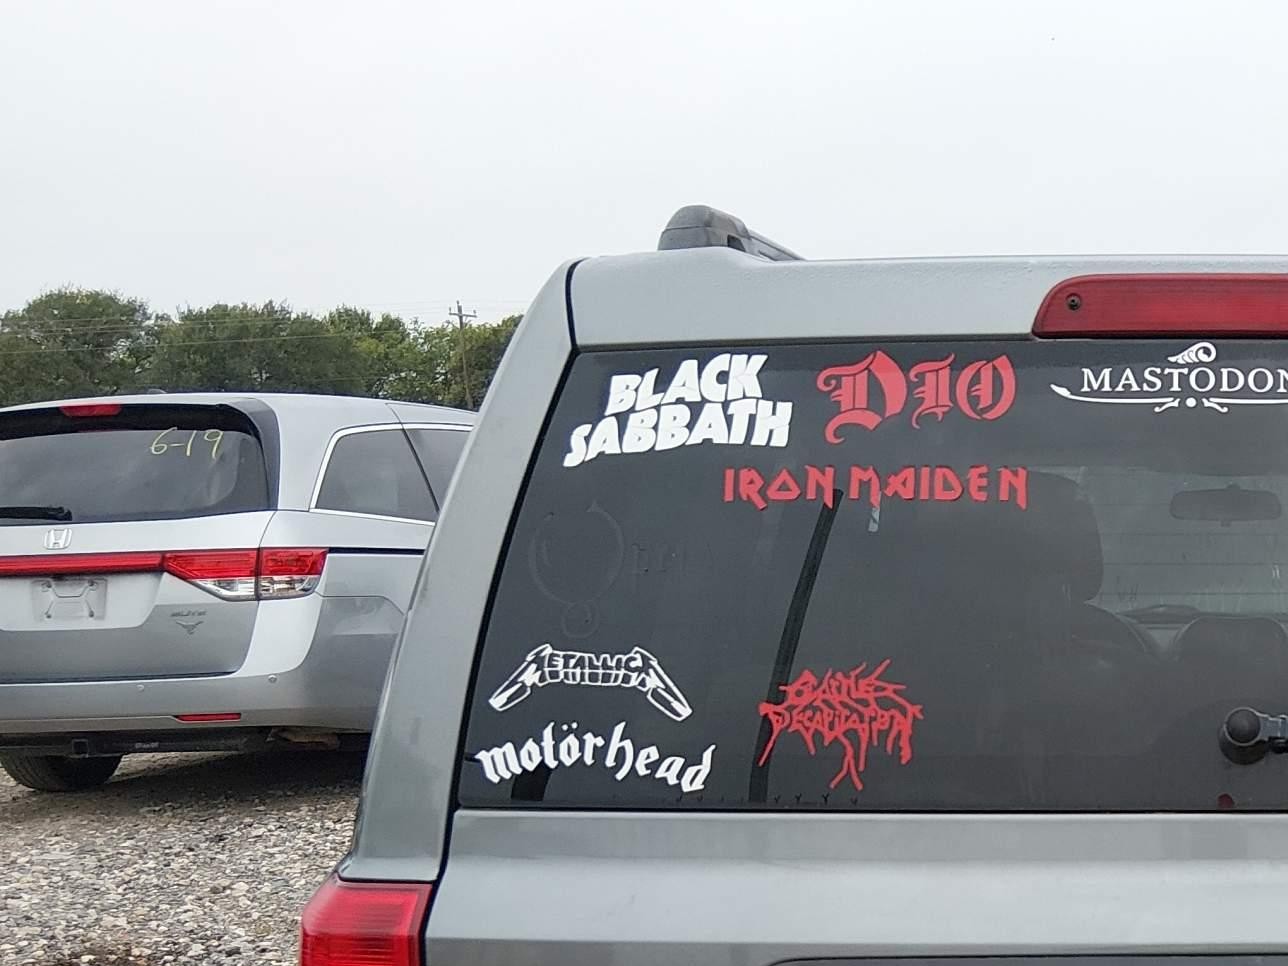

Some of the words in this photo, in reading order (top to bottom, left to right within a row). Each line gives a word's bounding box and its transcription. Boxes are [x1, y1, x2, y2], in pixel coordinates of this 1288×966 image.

[604, 353, 769, 416] BLACK
[816, 350, 1017, 445] DIO
[149, 426, 224, 460] 6-19
[562, 399, 794, 468] SABBATH
[723, 466, 837, 509] IRON
[848, 465, 1029, 510] MAIDEN
